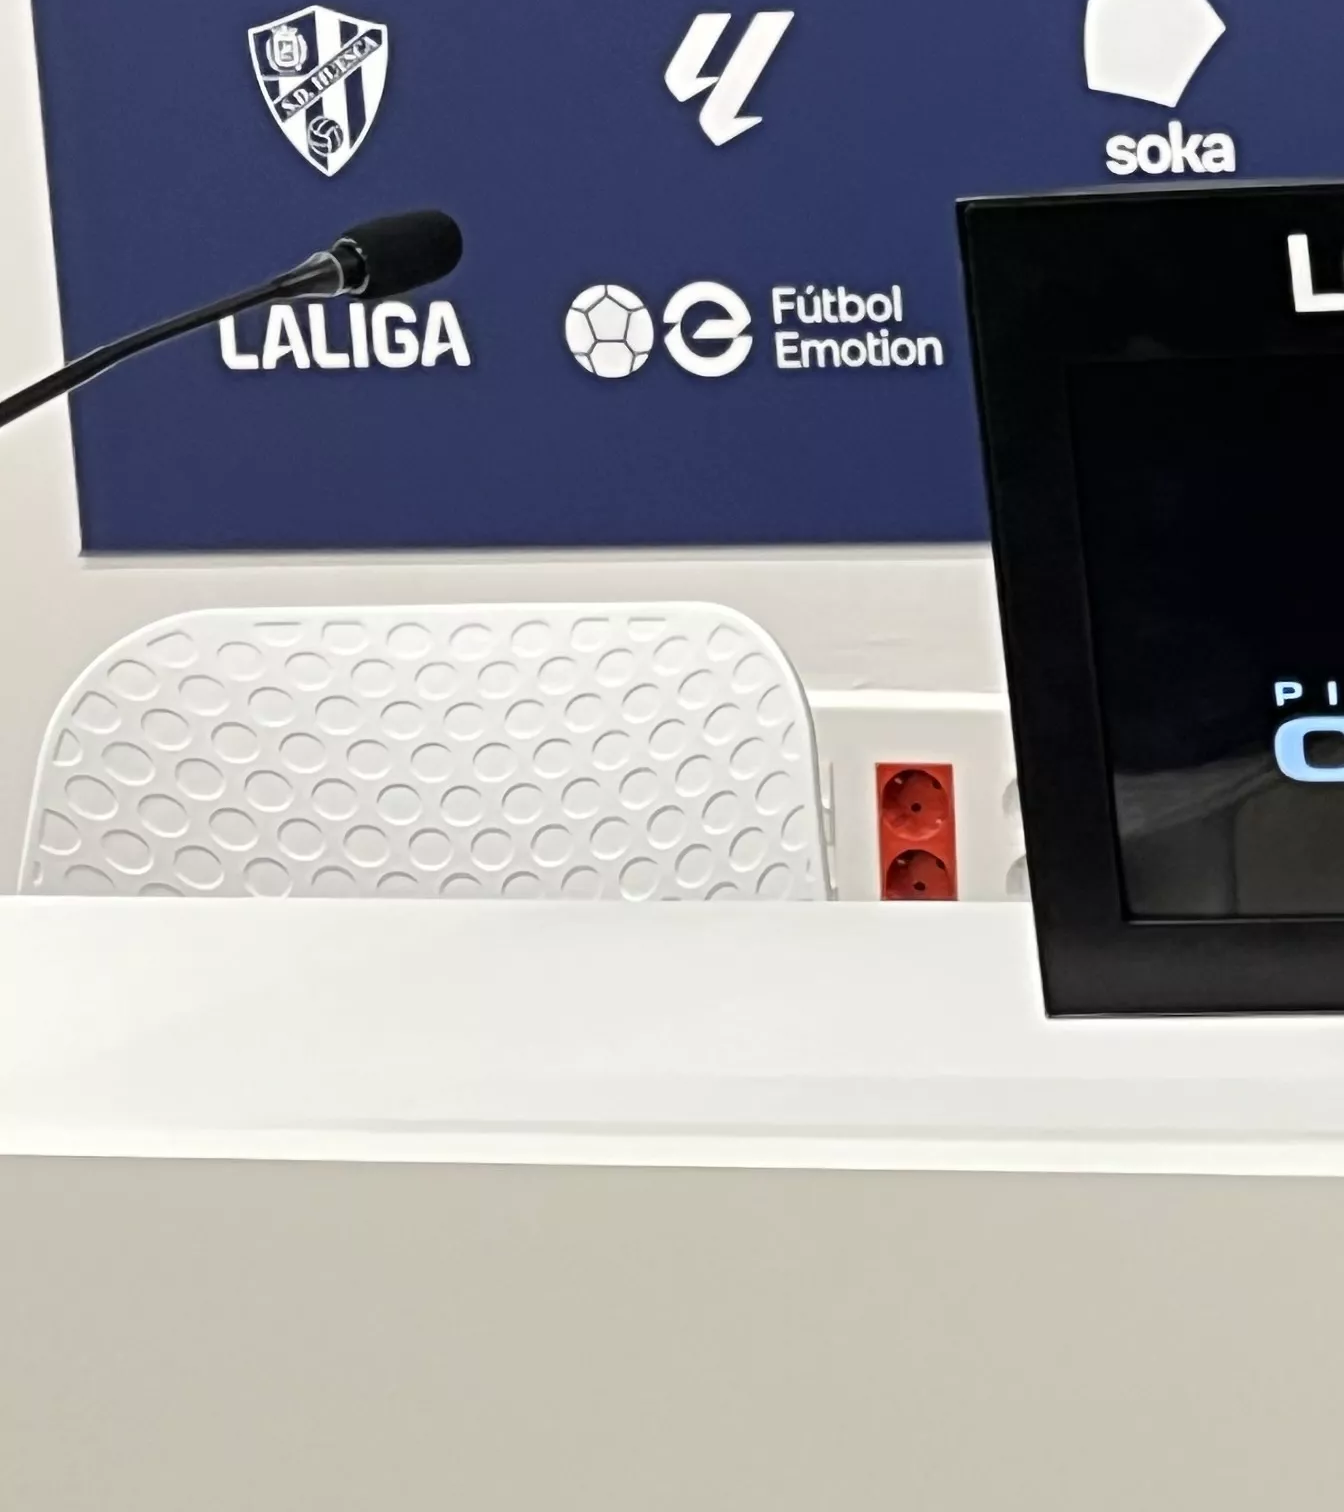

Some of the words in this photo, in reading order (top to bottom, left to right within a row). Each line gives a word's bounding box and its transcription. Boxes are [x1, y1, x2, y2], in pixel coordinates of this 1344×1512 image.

[1105, 120, 1236, 176] soka
[771, 284, 903, 325] Fútbol
[218, 300, 471, 370] LALIGA
[775, 328, 943, 369] Emotion
